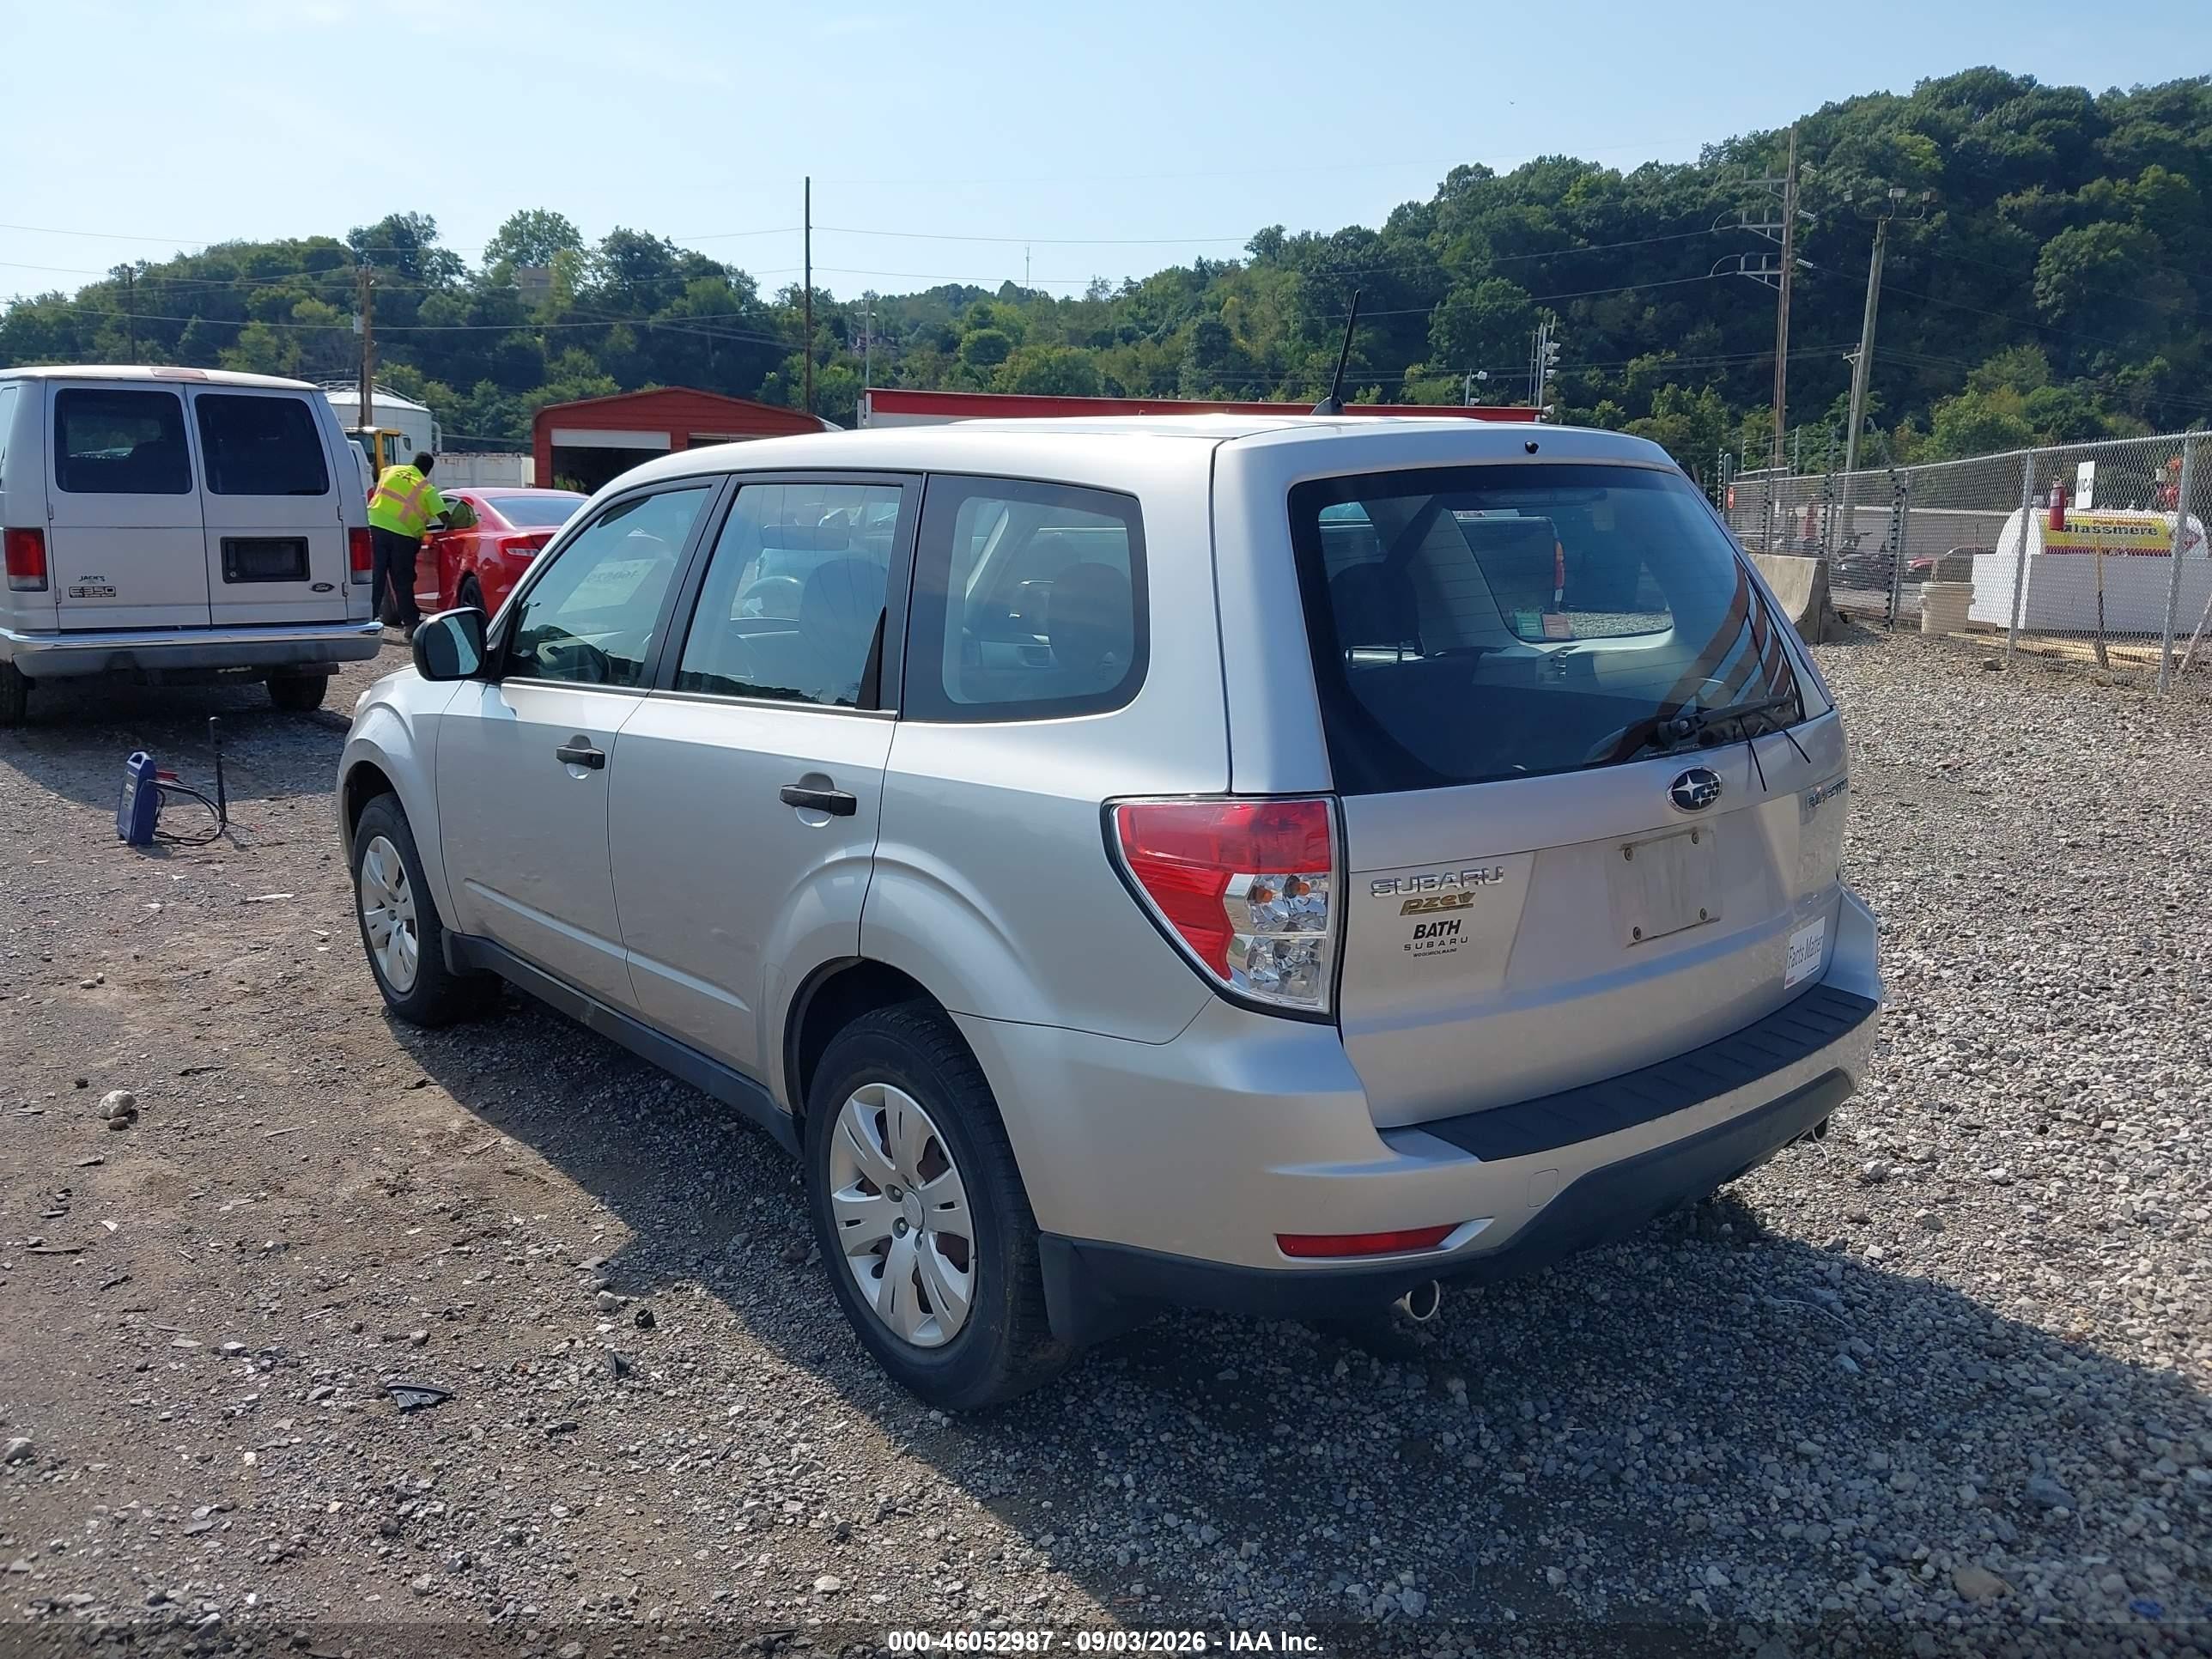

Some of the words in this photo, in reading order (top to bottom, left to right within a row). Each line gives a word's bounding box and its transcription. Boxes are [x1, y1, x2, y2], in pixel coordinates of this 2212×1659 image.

[1371, 866, 1504, 898] SUBARU
[1413, 919, 1462, 939] BATH
[1404, 936, 1468, 951] SUBARU
[1788, 945, 1806, 969] Facts
[1805, 934, 1823, 961] Matter
